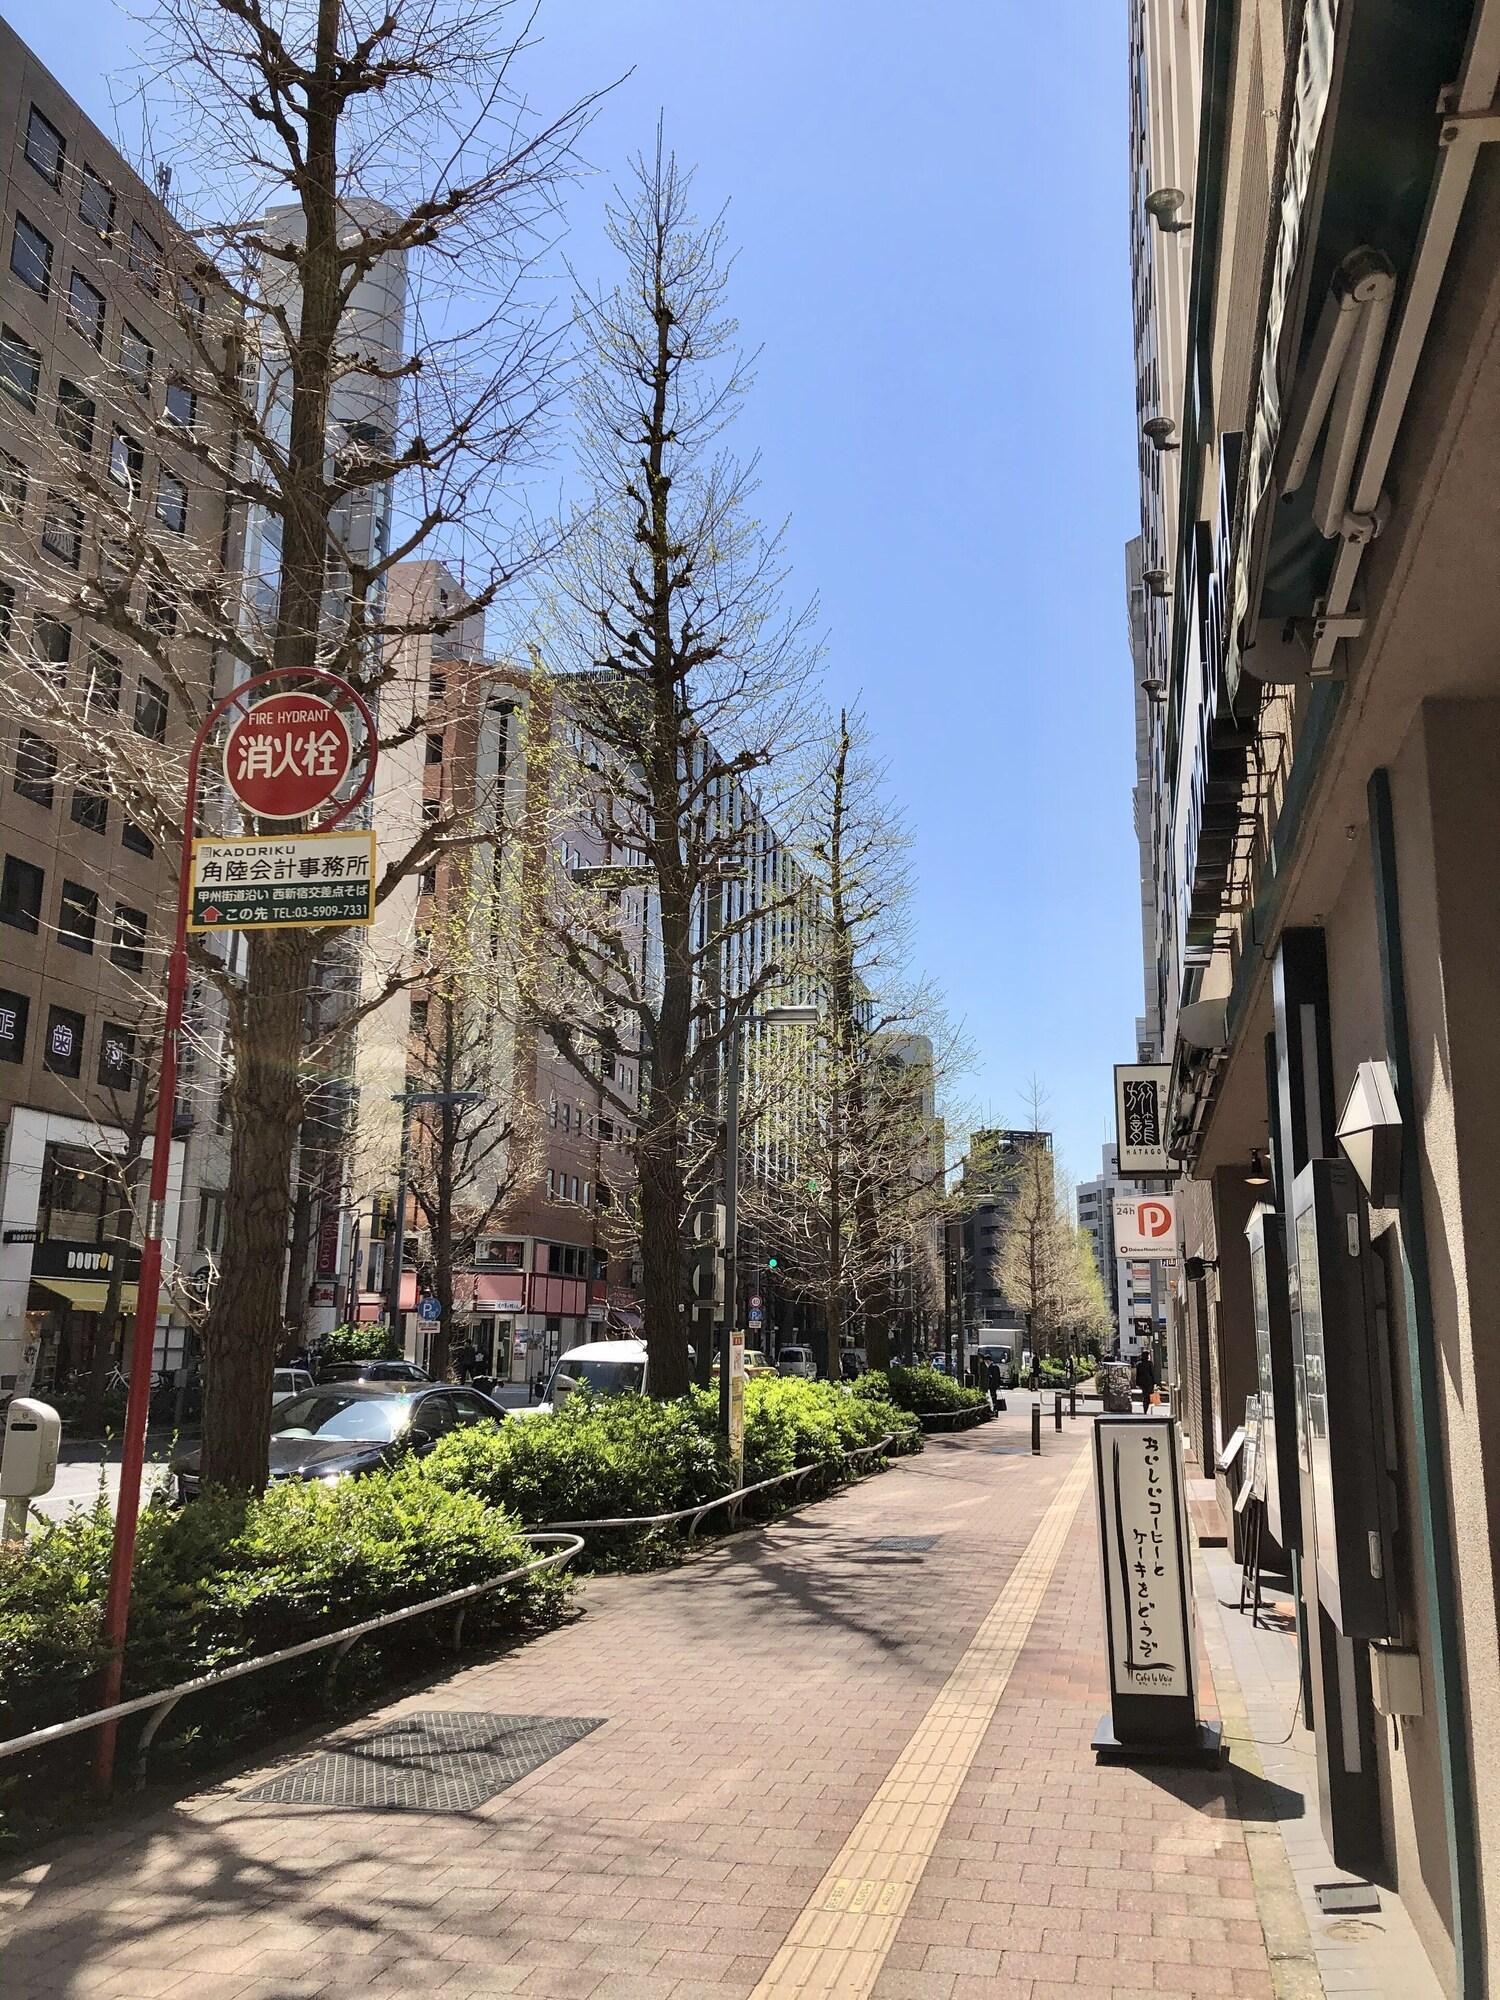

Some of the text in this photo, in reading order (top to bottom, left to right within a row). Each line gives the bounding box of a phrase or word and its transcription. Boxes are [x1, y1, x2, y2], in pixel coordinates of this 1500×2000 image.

[248, 709, 331, 726] FIRE HYDRANT
[236, 730, 342, 781] 消火栓
[211, 845, 296, 858] KADORIKU
[200, 854, 371, 884] 角陸会計事務所
[197, 884, 369, 903] 甲州街道沿い 西新宿交差点そば
[225, 904, 368, 921] この先 TEL:03-5909-7331
[1126, 1147, 1162, 1156] HATAGO
[1116, 1206, 1135, 1216] 24h
[1142, 1436, 1163, 1577] おいしいコーヒーと
[1133, 1529, 1158, 1658] ケーキをどうぞ
